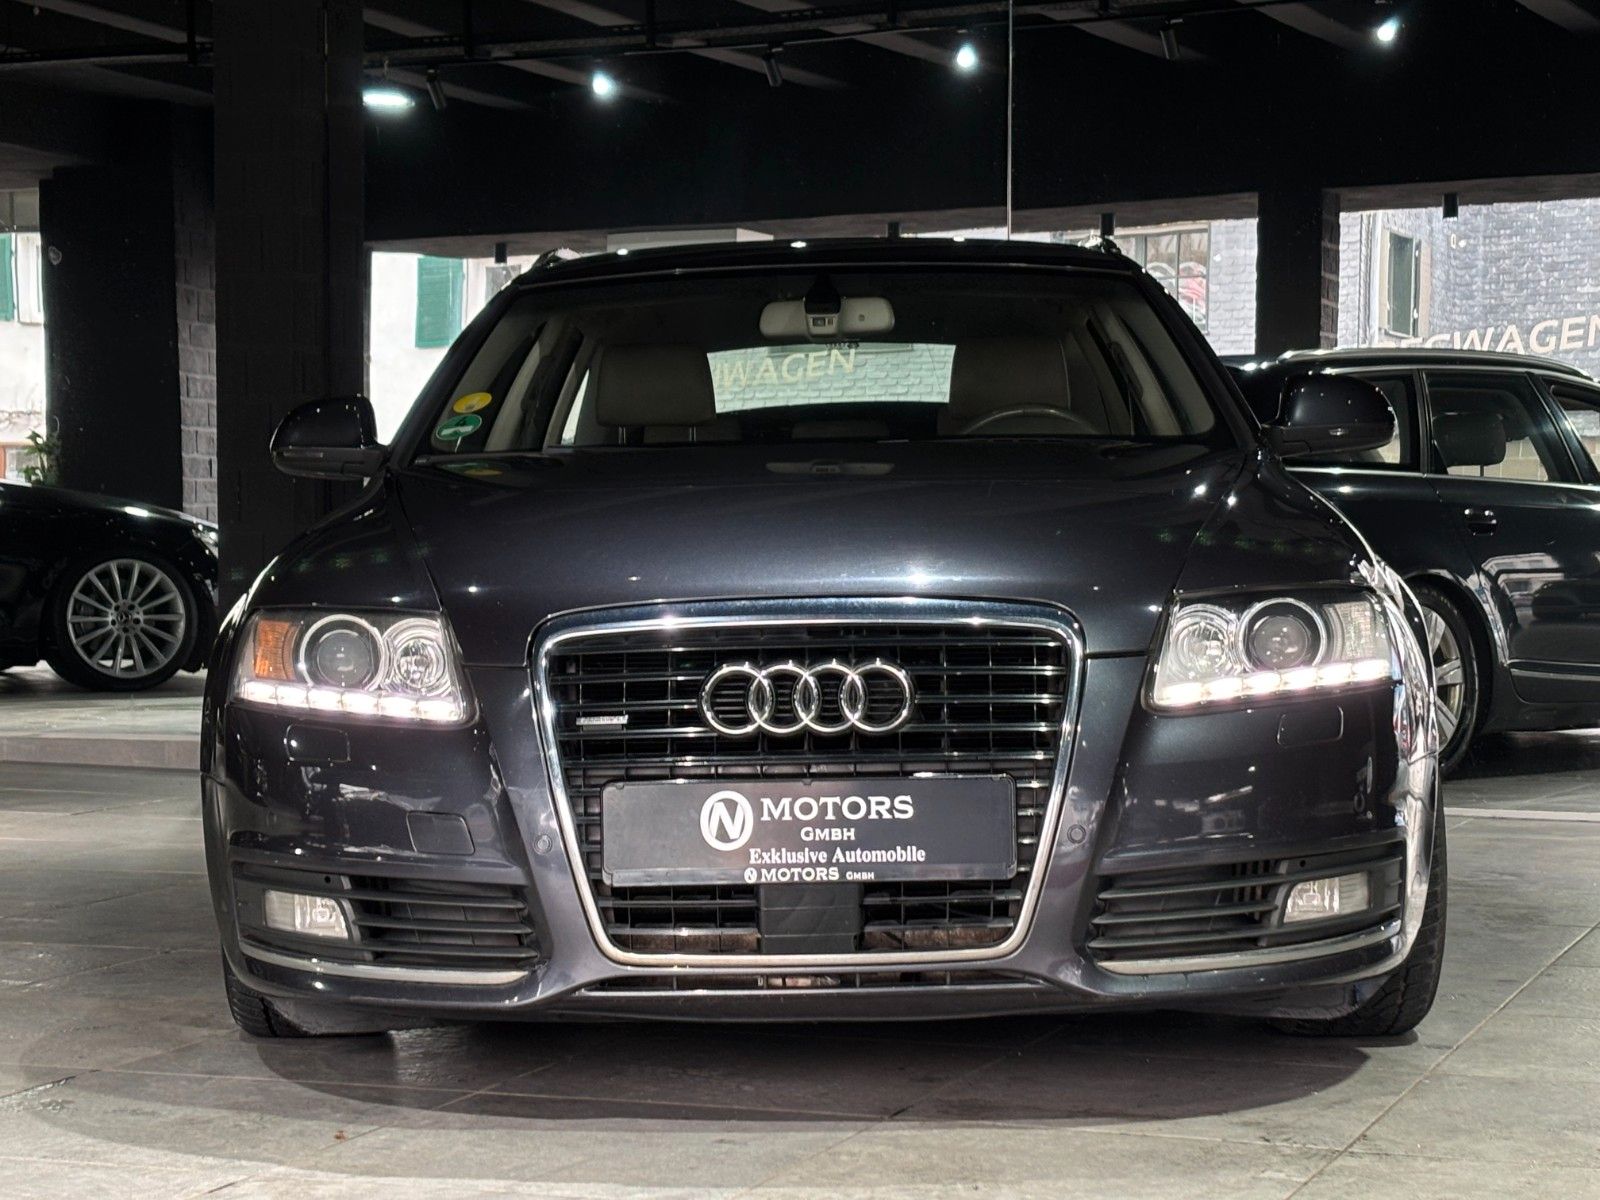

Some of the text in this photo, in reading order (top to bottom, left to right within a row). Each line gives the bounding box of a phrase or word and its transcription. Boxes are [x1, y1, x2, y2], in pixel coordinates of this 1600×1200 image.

[760, 795, 914, 821] MOTORS
[800, 827, 856, 841] GMBH
[749, 846, 925, 864] Exklusive Automobile
[761, 867, 839, 881] MOTORS
[846, 871, 875, 880] GMBH
